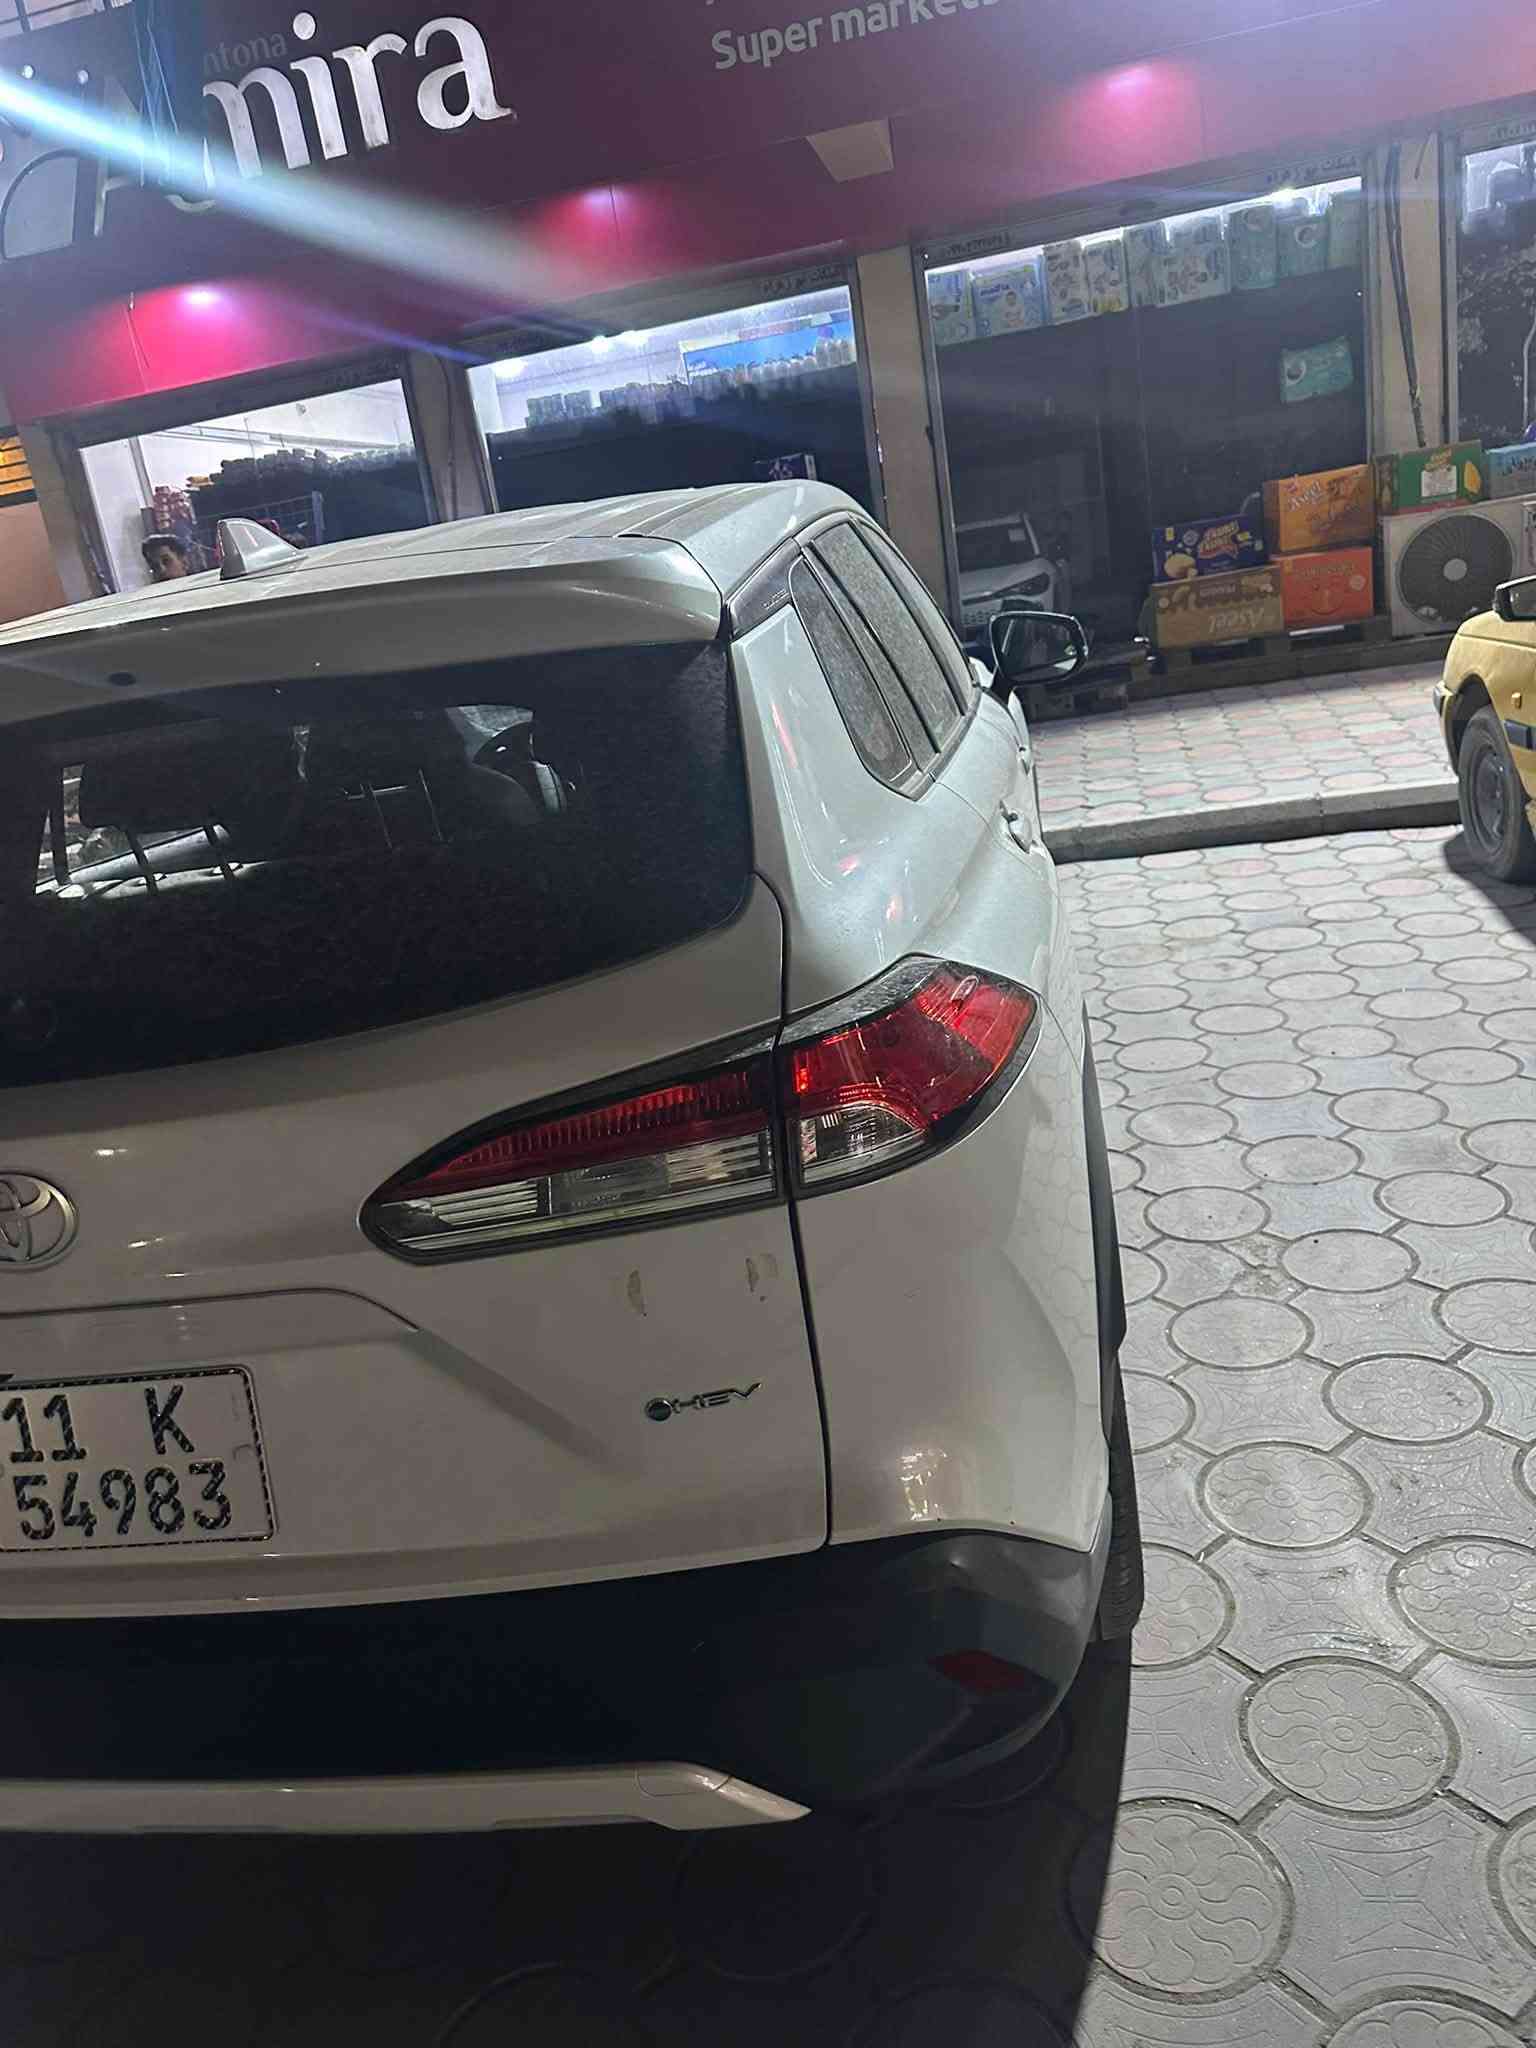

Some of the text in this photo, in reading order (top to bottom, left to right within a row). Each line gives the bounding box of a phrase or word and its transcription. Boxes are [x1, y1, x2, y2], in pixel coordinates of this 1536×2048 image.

[711, 0, 1000, 69] Super marke
[2, 1384, 195, 1463] 11 K
[13, 1460, 231, 1540] 54983
